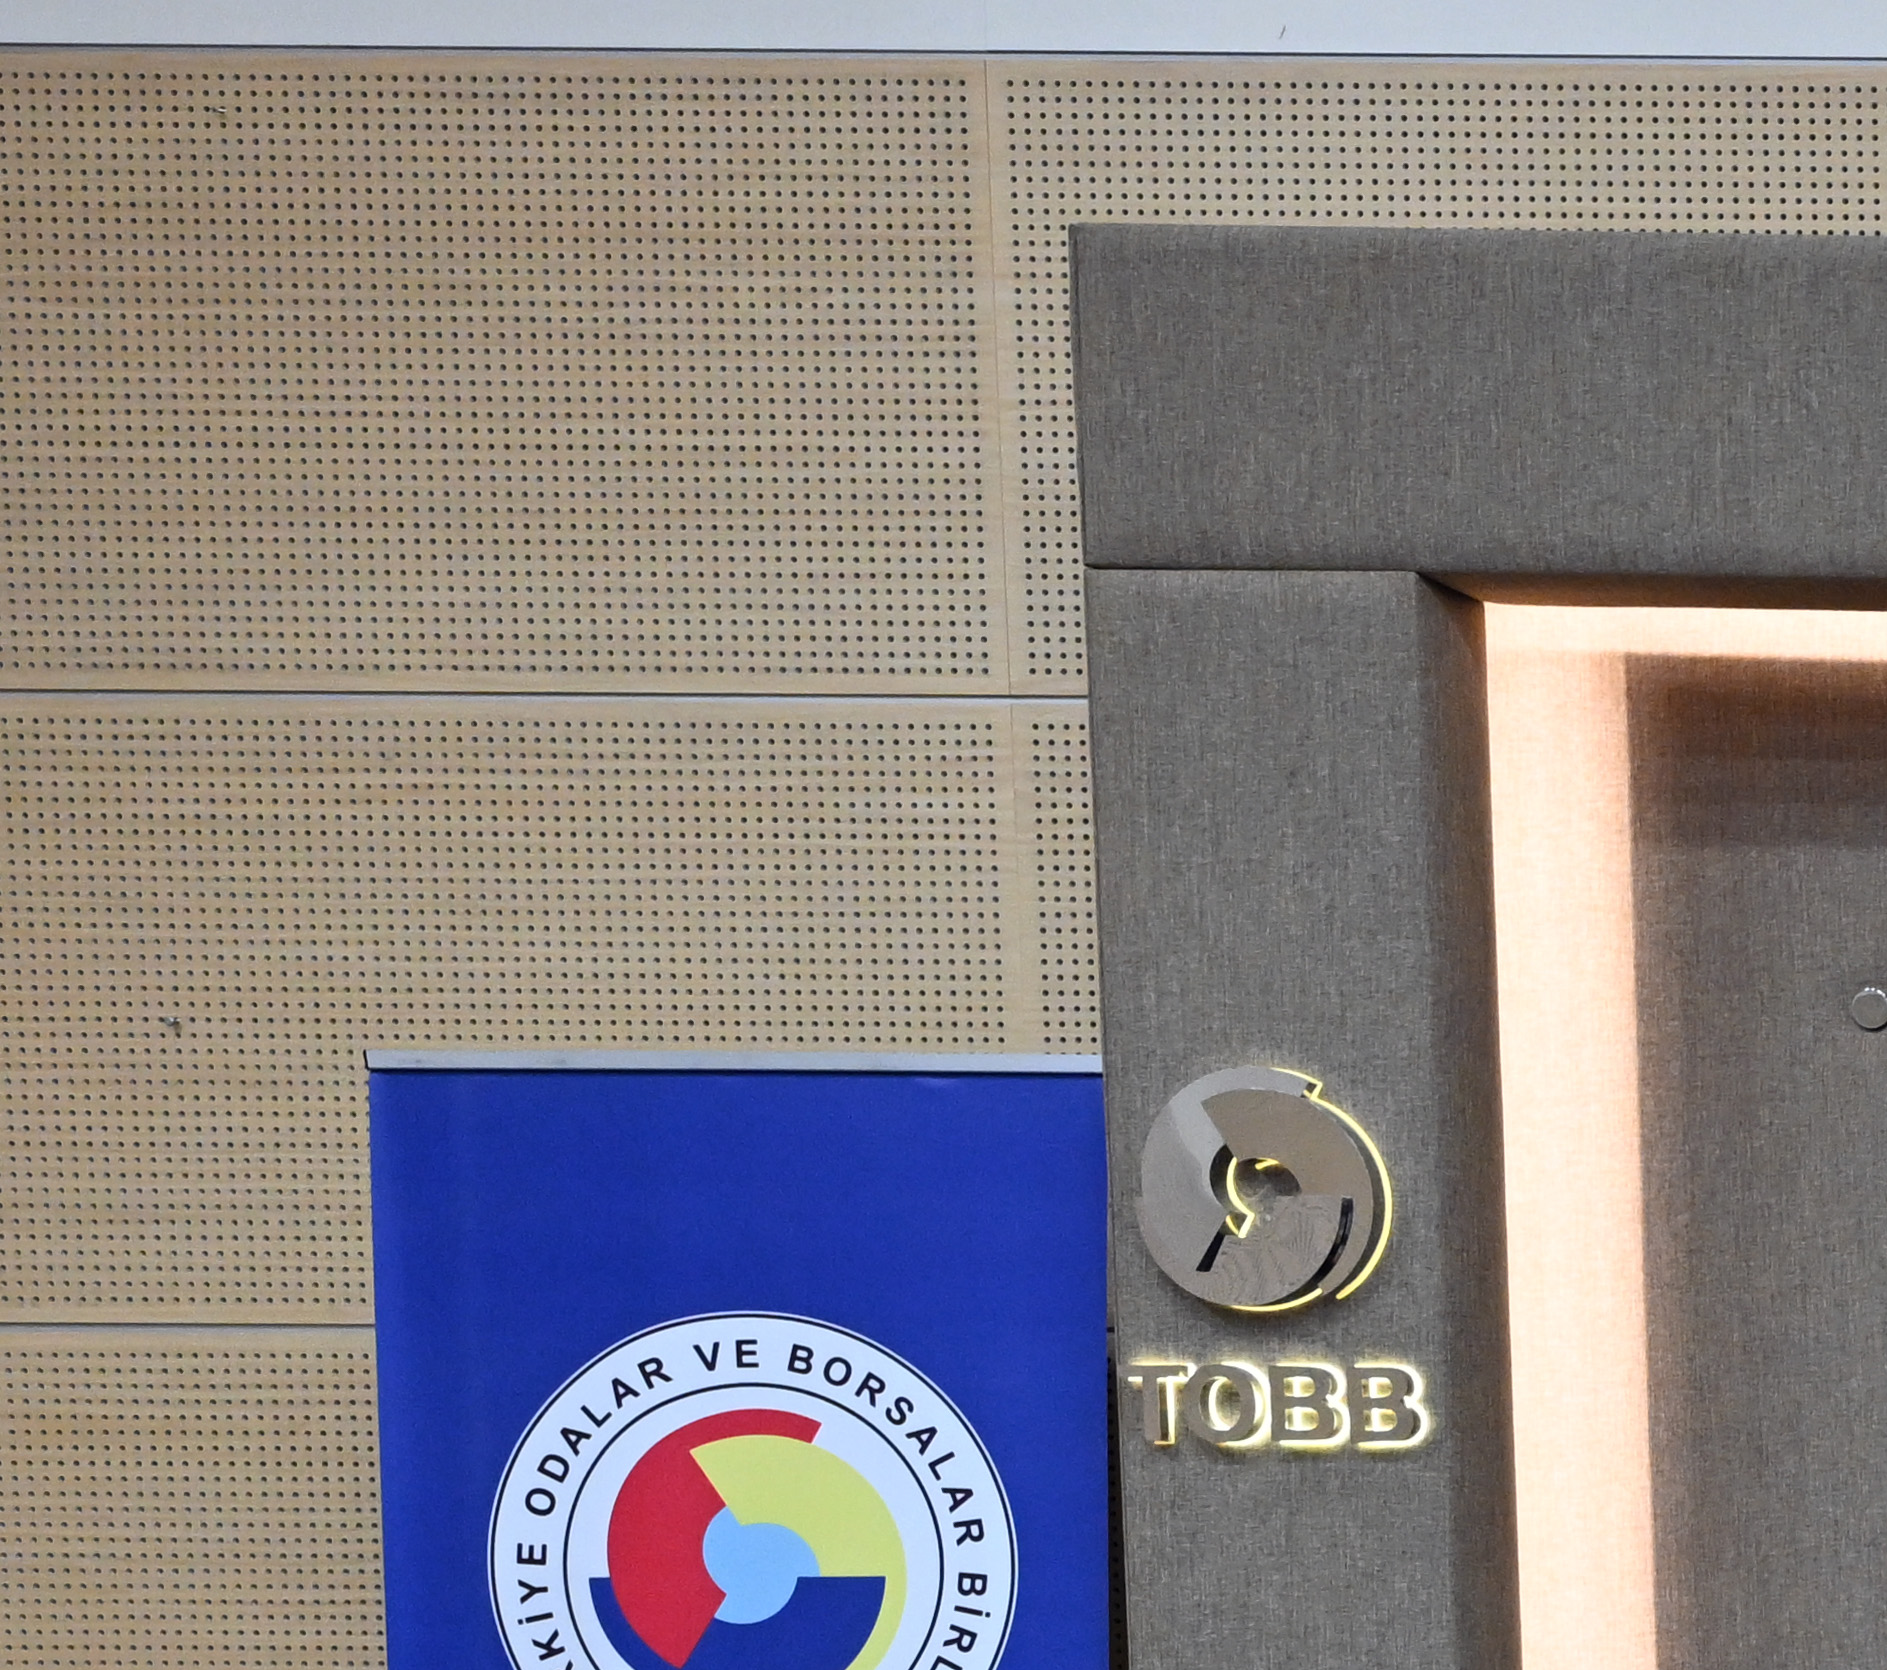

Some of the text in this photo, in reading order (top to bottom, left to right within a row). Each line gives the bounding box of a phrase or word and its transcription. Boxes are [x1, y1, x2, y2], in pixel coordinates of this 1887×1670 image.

[524, 1356, 673, 1517] ODALAR
[693, 1339, 760, 1372] VE
[787, 1343, 985, 1547] BORSALAR
[1118, 1361, 1430, 1446] TOBB
